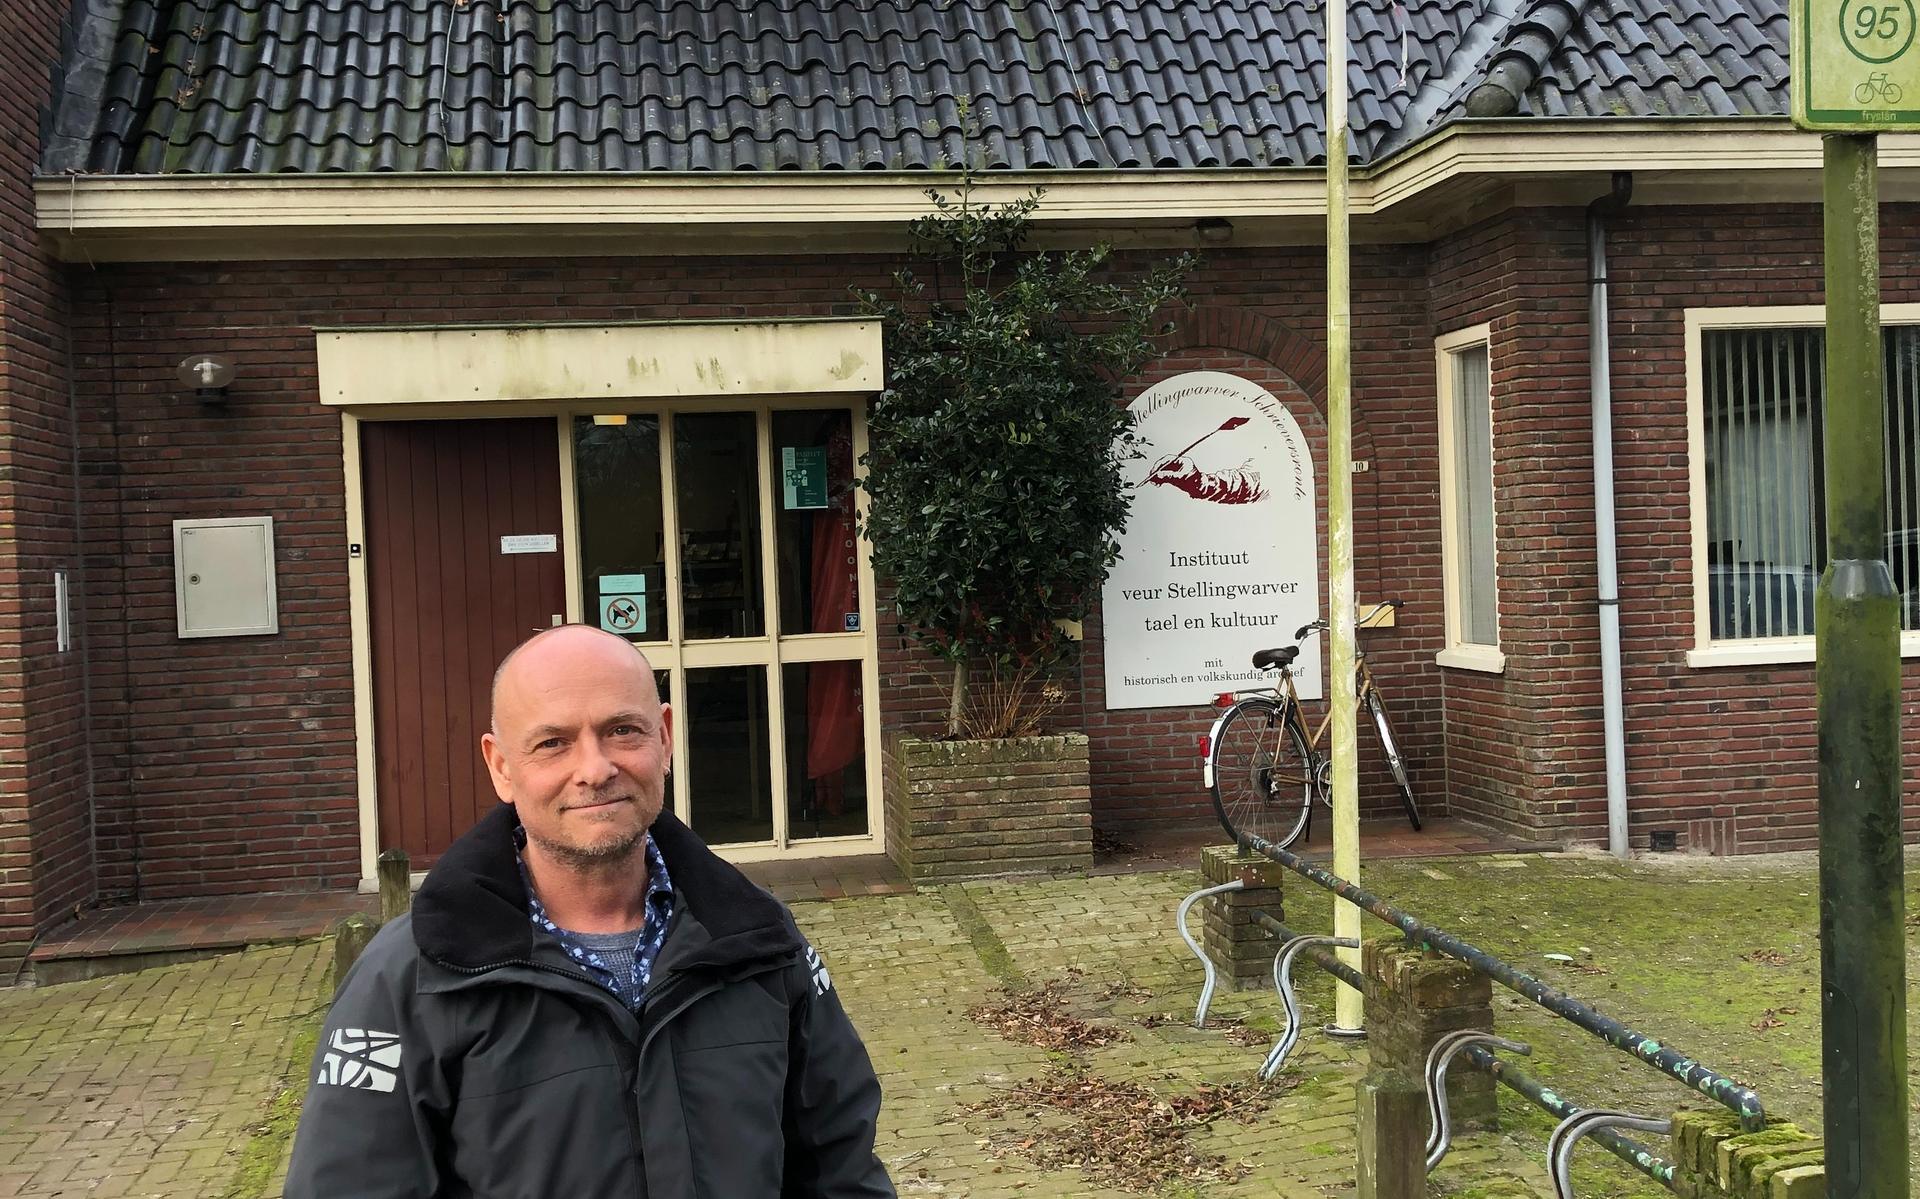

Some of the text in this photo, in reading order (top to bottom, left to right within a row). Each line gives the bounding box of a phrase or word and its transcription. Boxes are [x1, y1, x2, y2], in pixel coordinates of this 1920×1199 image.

[1854, 6, 1900, 39] 95
[1131, 384, 1240, 432] Stellingwarver
[1354, 461, 1364, 472] 10
[1168, 550, 1250, 568] Instituut
[1121, 580, 1299, 601] veur Stellingwarver
[1144, 611, 1279, 632] tael en kultuur
[1204, 657, 1224, 669] mit
[1124, 673, 1178, 687] historisch
[1180, 674, 1195, 684] en
[1196, 667, 1264, 683] volkskundig
